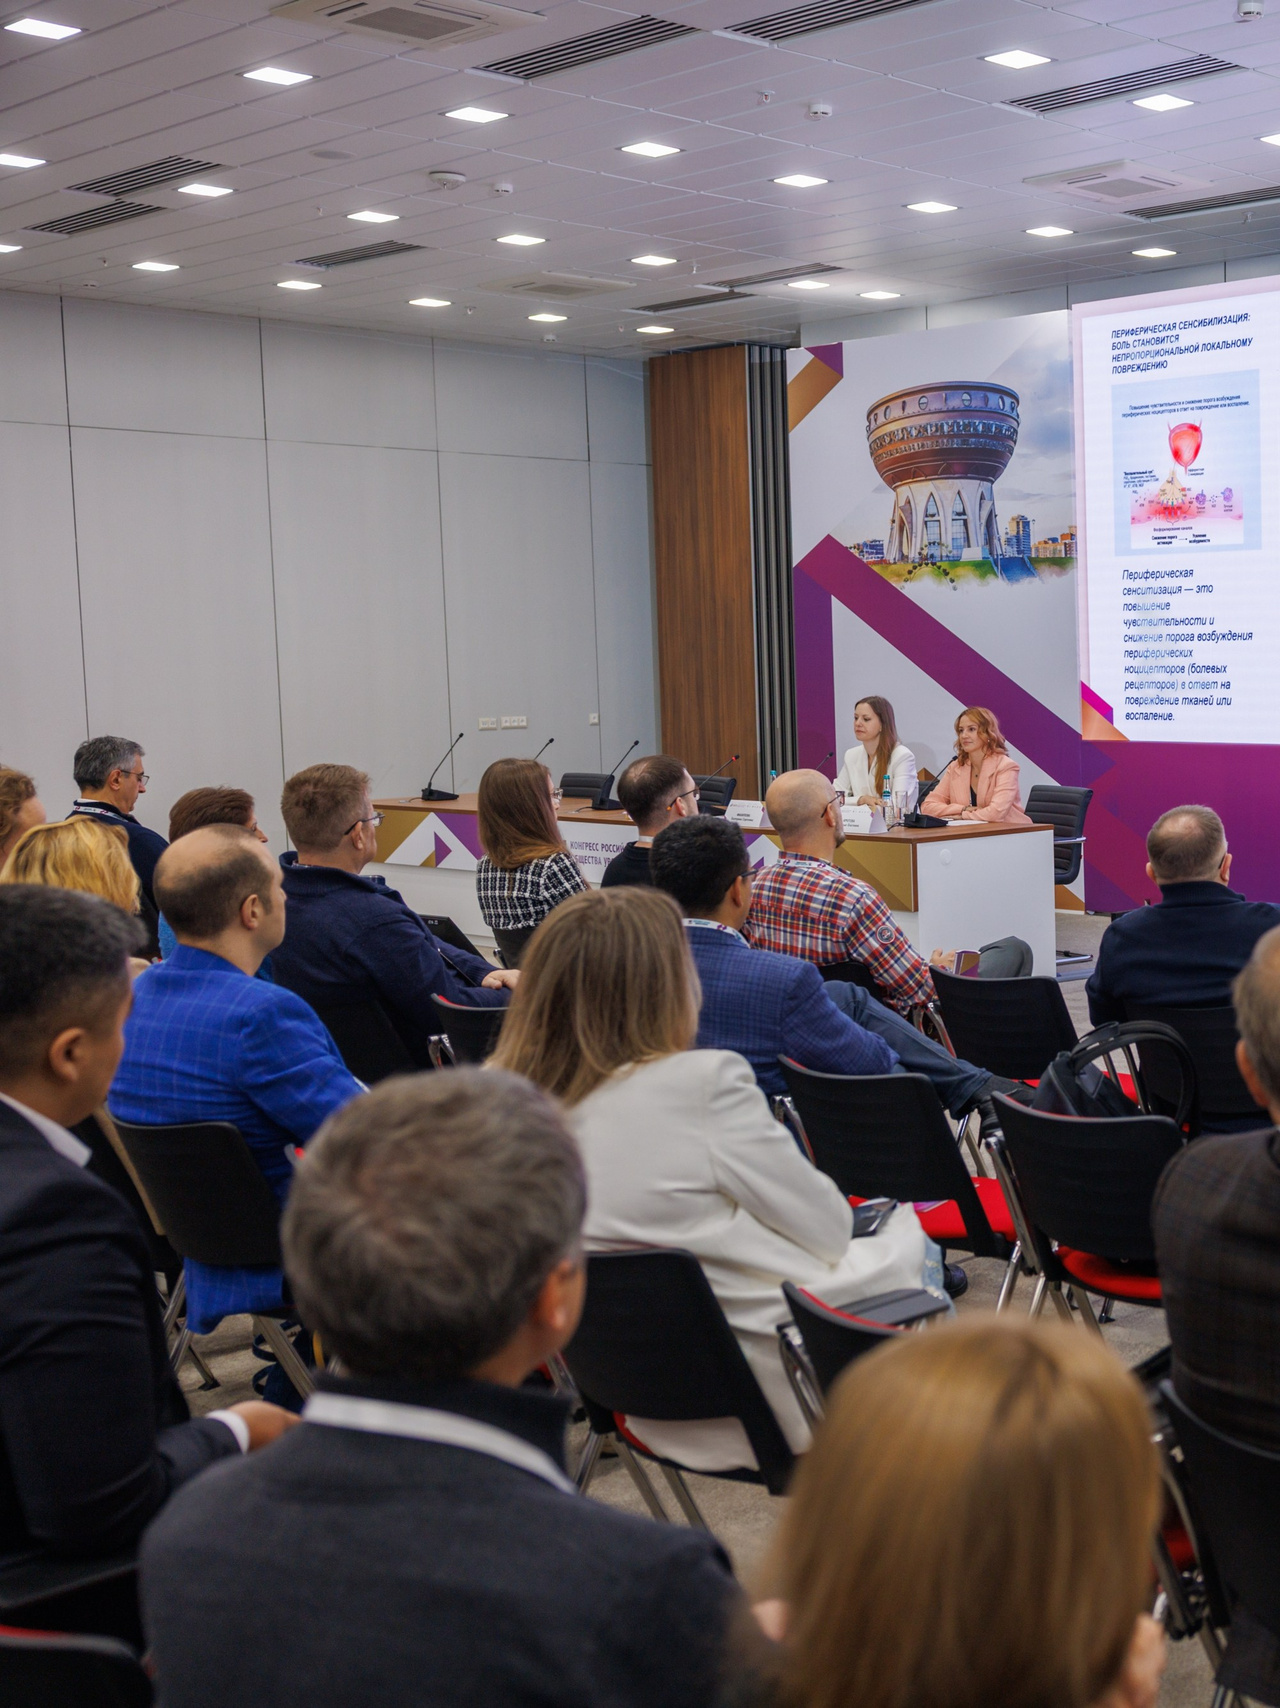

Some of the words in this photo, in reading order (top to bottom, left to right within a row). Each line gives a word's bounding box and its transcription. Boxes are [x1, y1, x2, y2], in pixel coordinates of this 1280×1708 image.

[1111, 323, 1177, 339] ПЕРИФЕРИЧЕСКАЯ
[1179, 313, 1251, 330] СЕНСИБИЛИЗАЦИЯ:
[1112, 341, 1130, 350] БОЛЬ
[1132, 334, 1180, 348] СТАНОВИТСЯ
[1112, 343, 1200, 362] НЕПРОПОРЦИОНАЛЬНОЙ
[1201, 337, 1253, 352] ЛОКАЛЬНОМУ
[1112, 360, 1168, 374] ПОВРЕЖДЕНИЮ
[1122, 569, 1194, 582] Периферическая
[1123, 585, 1182, 596] сенситизация
[1196, 584, 1213, 594] это
[1123, 601, 1170, 611] повышение
[1123, 616, 1207, 629] чувствительности
[1209, 616, 1215, 625] и
[1124, 631, 1163, 642] снижение
[1165, 632, 1195, 644] порога
[1197, 630, 1253, 644] возбуждения
[1124, 648, 1193, 660] периферических
[1124, 665, 1185, 676] ноцицепторов
[1188, 663, 1227, 676] (болевых
[1125, 679, 1178, 691] рецепторов)
[1181, 681, 1186, 689] в
[1188, 681, 1218, 690] ответ
[1220, 681, 1231, 689] на
[1125, 695, 1179, 706] повреждение
[1182, 695, 1214, 706] тканей
[1216, 696, 1232, 706] или
[1126, 711, 1175, 721] воспаление.
[570, 841, 599, 851] КОНГРЕСС
[601, 843, 624, 853] РОССИЙ
